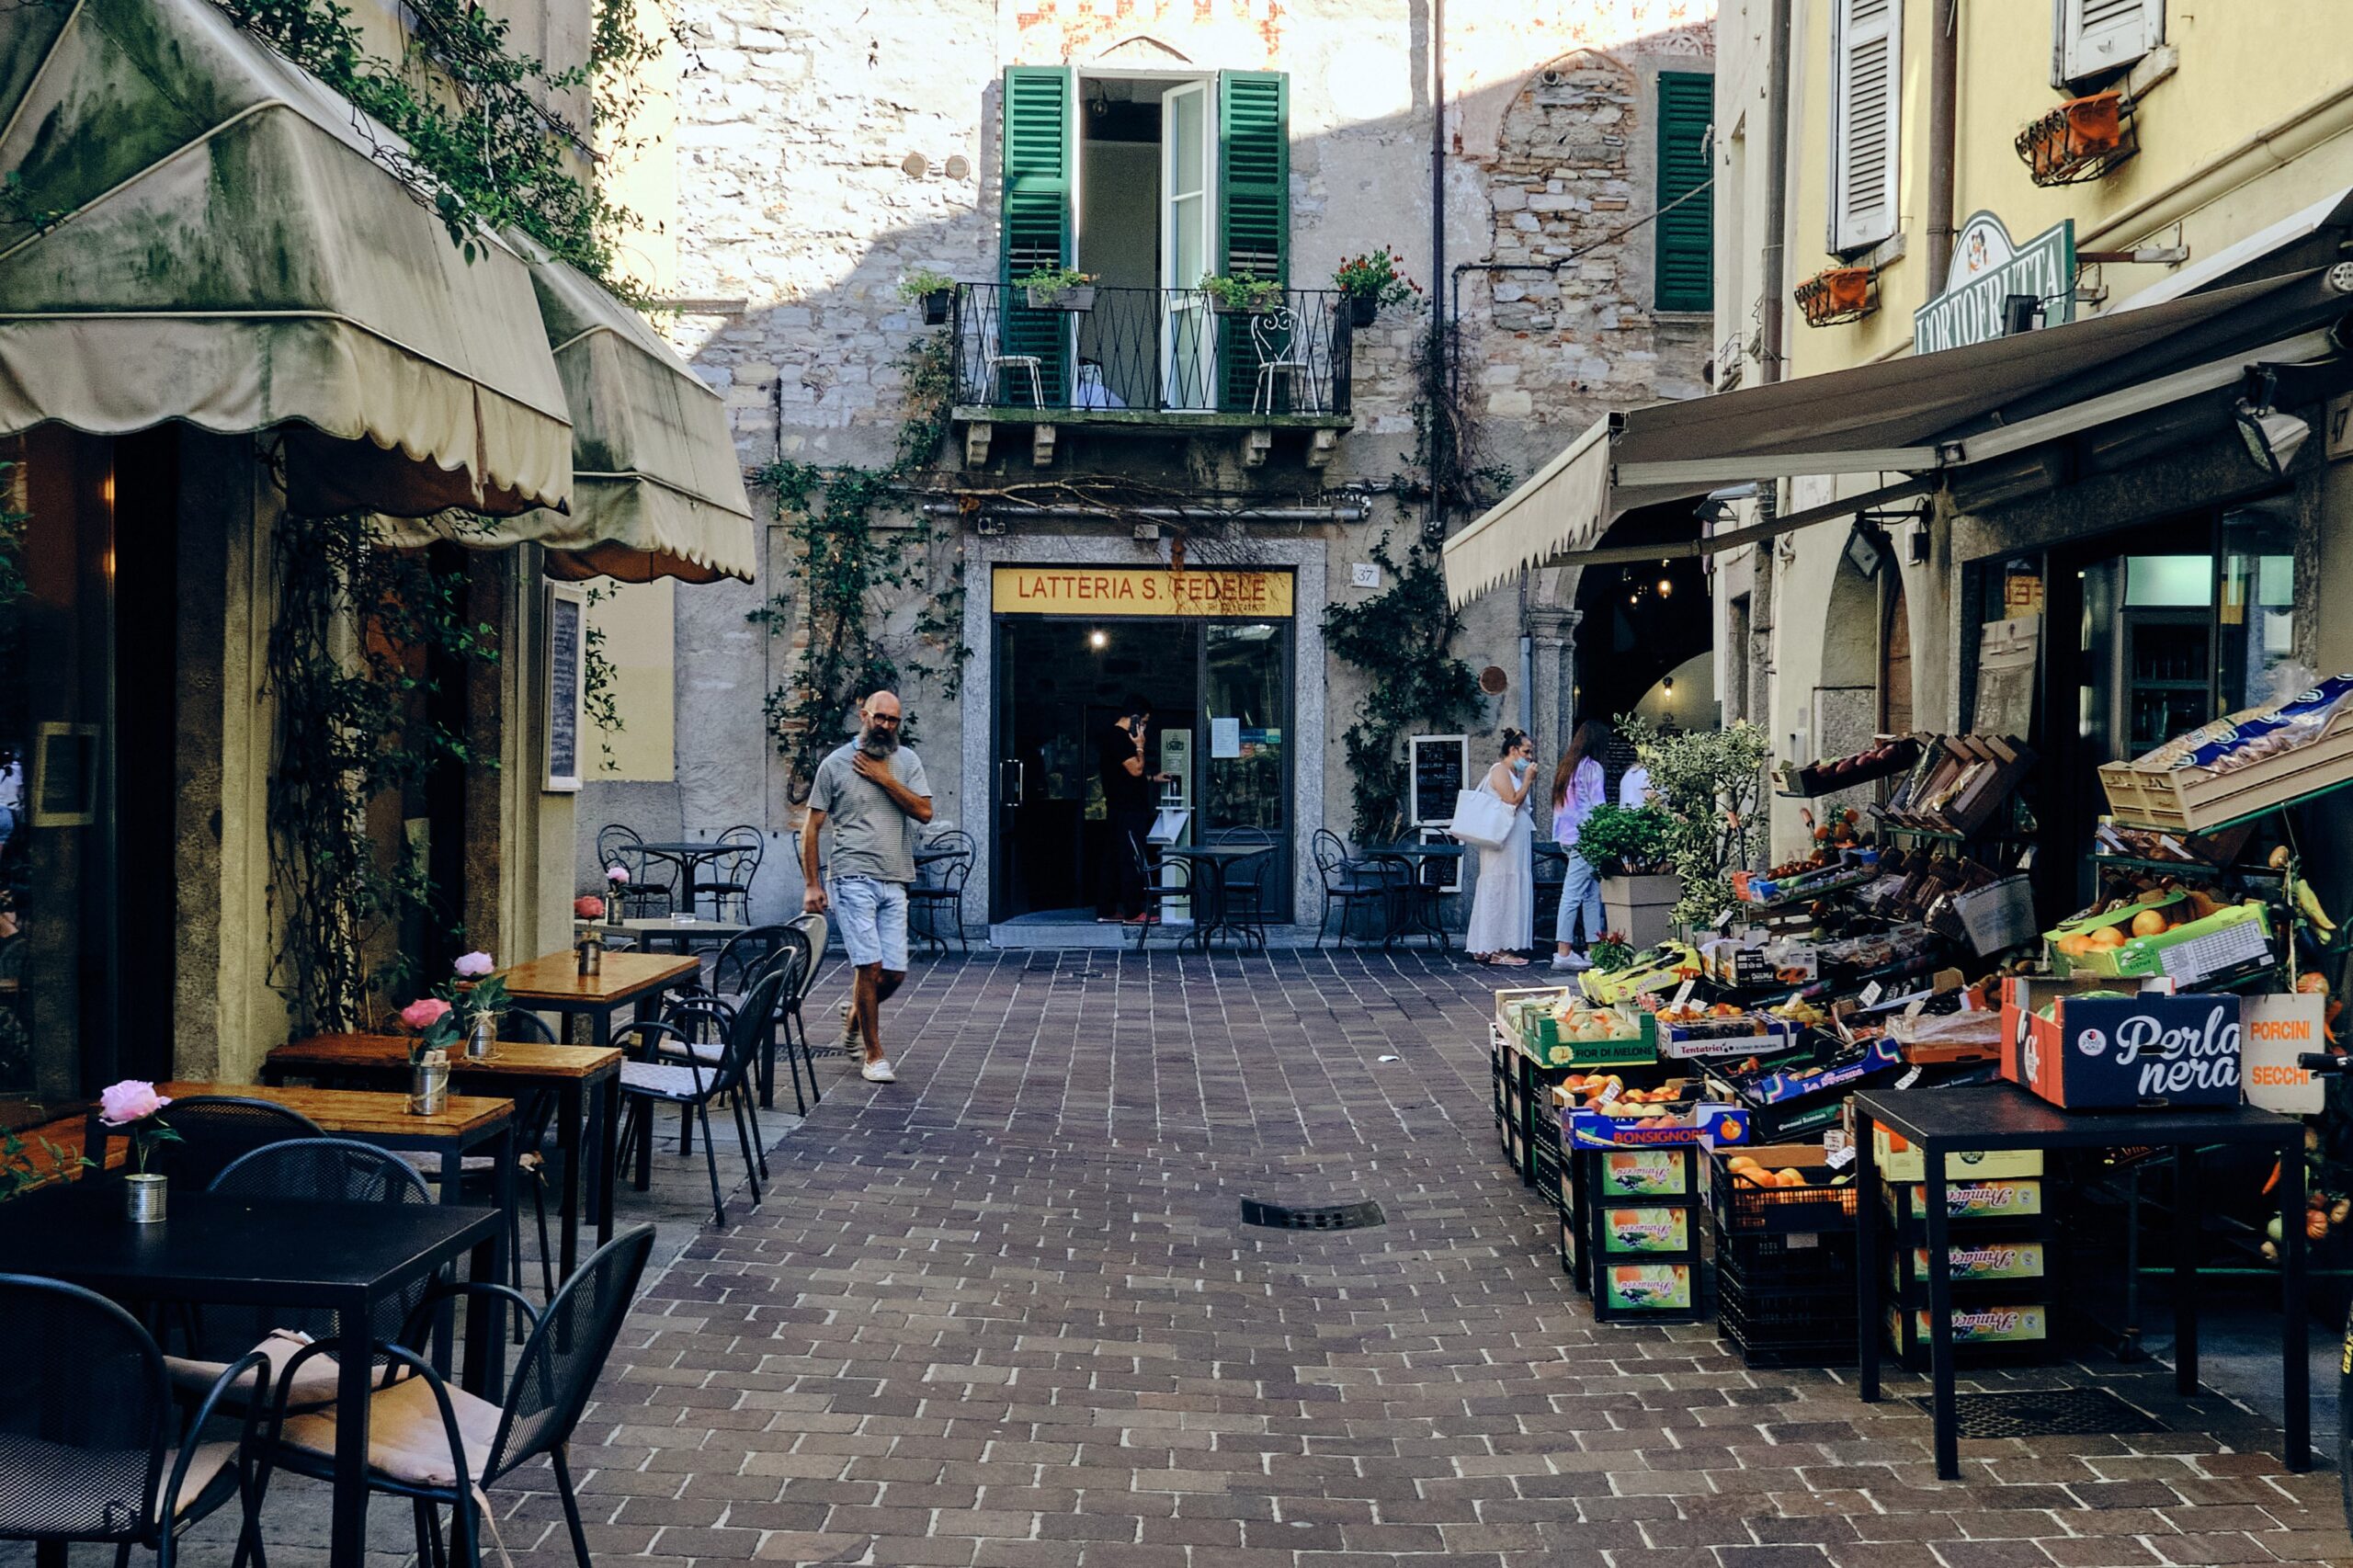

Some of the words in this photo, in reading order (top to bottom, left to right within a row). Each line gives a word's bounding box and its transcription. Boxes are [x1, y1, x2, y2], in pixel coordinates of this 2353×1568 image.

[1358, 569, 1373, 581] 37
[1018, 576, 1134, 599] LATTERIA
[1142, 578, 1163, 600] S.
[1173, 577, 1267, 601] FEDELE
[2116, 1006, 2240, 1065] Perla
[2250, 1020, 2310, 1040] PORCINI
[1575, 1048, 1597, 1058] FIOR
[1601, 1047, 1611, 1057] DI
[1614, 1046, 1653, 1057] MELONE
[2138, 1056, 2241, 1096] nera
[2252, 1066, 2309, 1085] SECCHI
